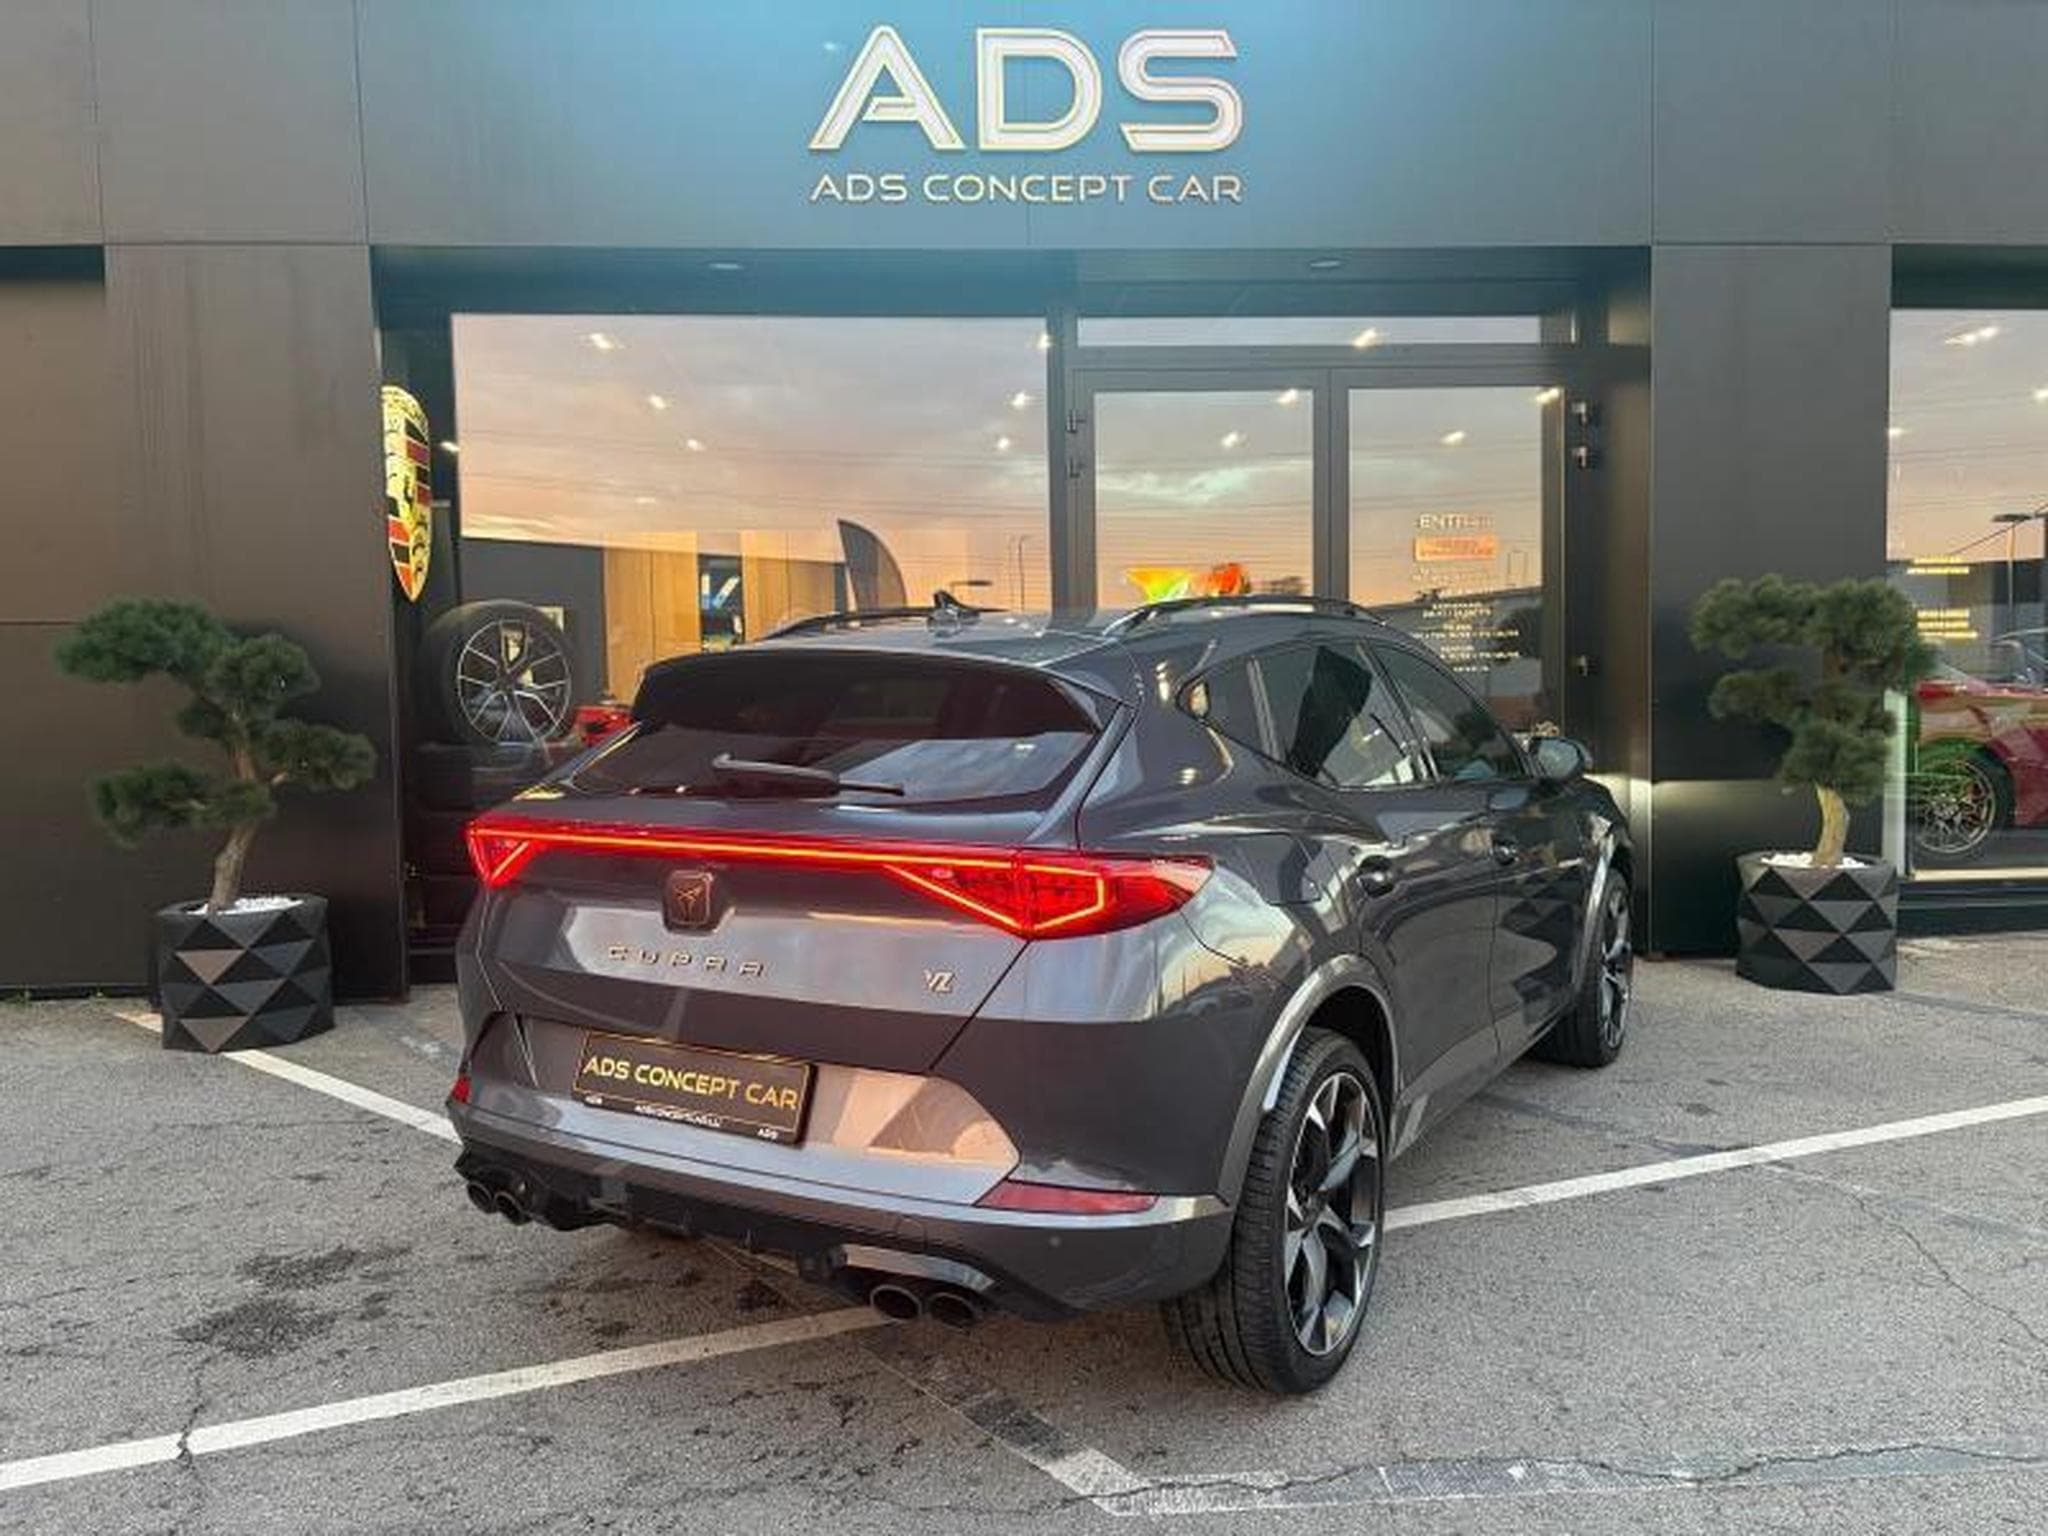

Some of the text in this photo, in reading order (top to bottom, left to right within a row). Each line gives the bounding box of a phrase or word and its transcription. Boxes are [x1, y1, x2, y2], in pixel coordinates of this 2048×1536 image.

[808, 24, 1244, 152] ADS
[810, 174, 1243, 203] ADS CONCEPT CAR
[606, 945, 767, 978] CUPRA
[583, 1056, 799, 1110] ADS CONCEPT CAR
